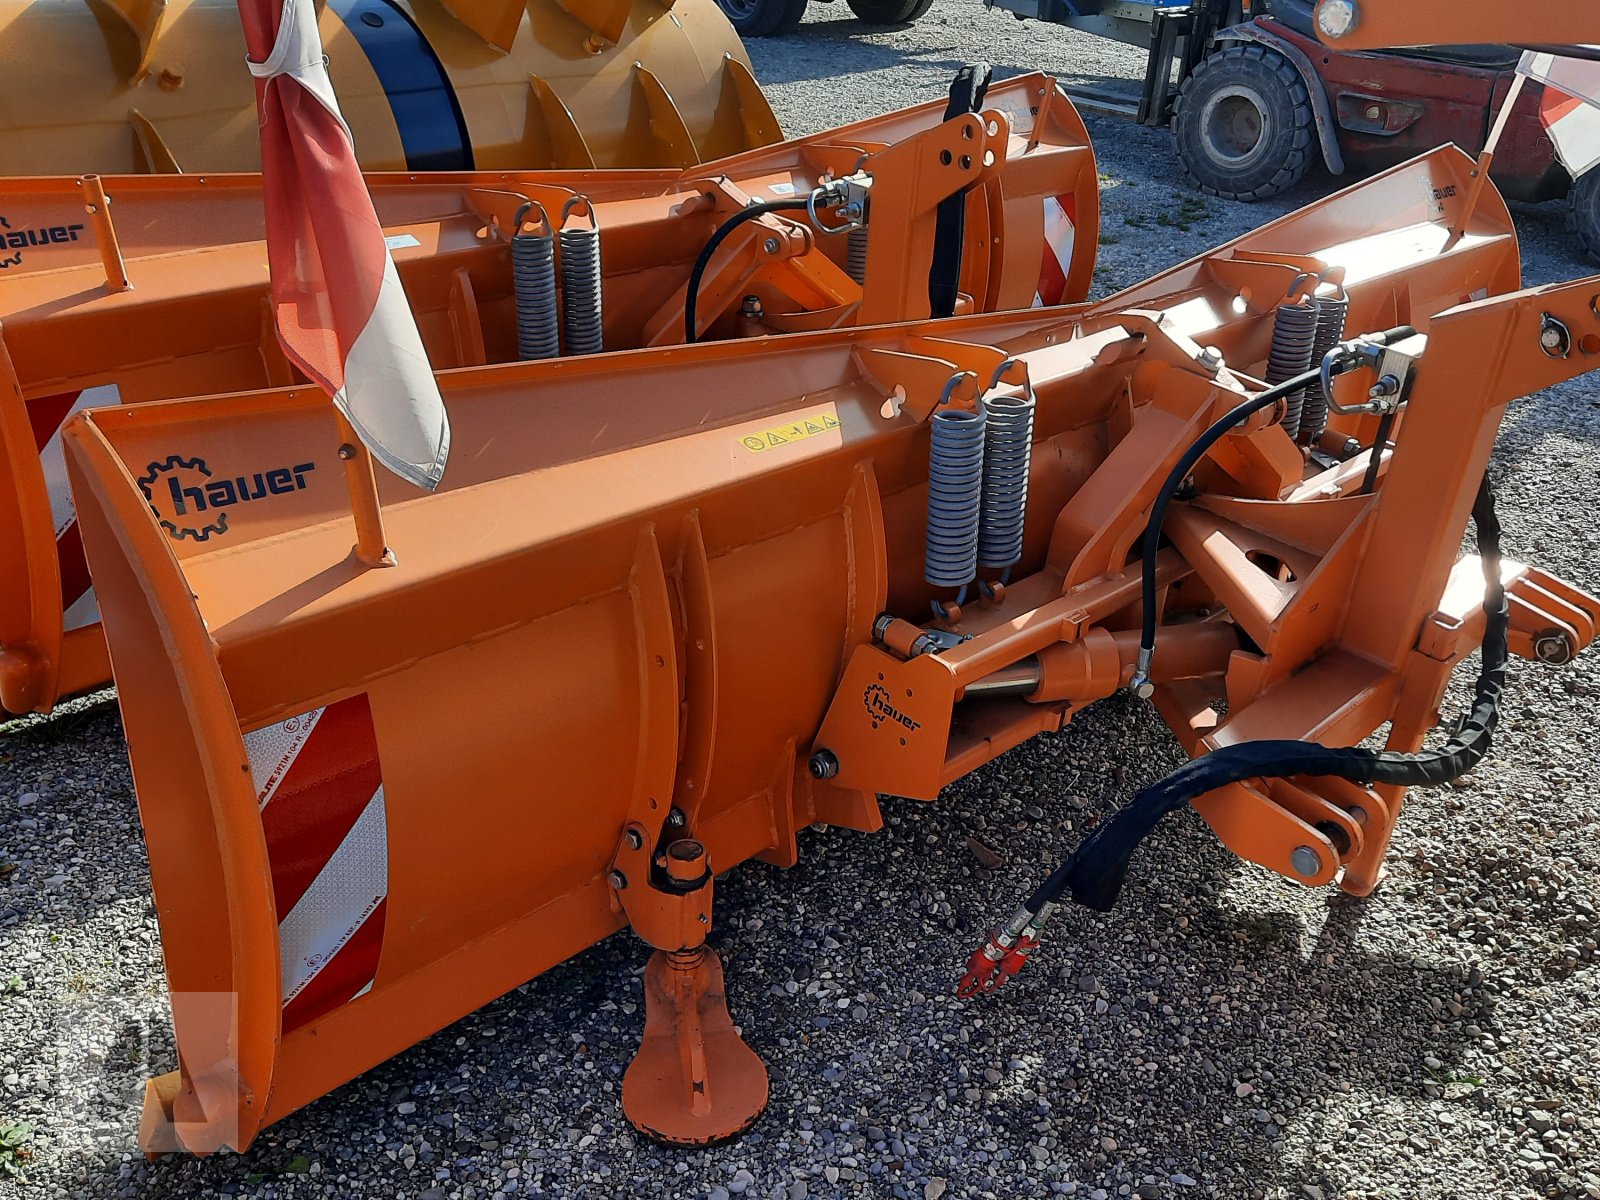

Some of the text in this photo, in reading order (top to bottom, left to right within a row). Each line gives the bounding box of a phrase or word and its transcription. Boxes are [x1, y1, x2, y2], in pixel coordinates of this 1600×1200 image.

[168, 462, 316, 516] hauer
[872, 692, 921, 732] hauer
[287, 742, 298, 755] 104
